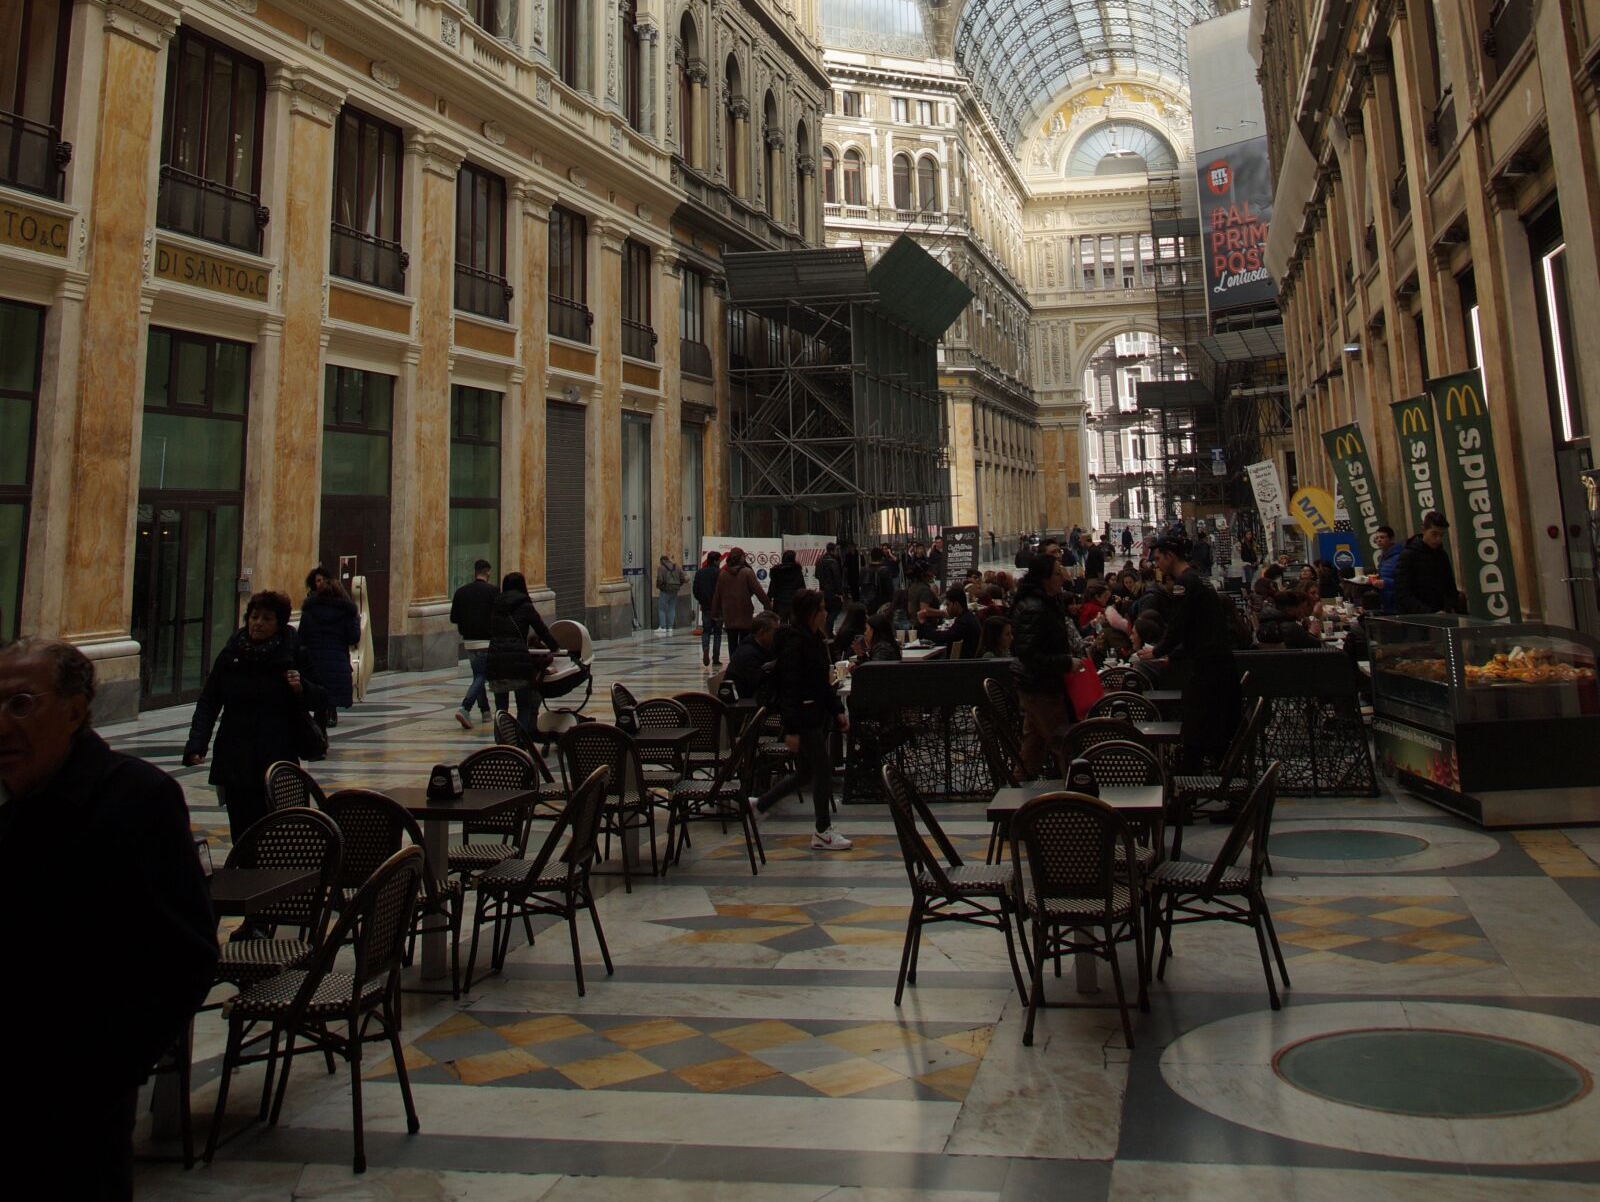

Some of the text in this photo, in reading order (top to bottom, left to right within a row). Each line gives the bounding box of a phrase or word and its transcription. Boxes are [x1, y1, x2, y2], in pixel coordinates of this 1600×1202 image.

[1211, 167, 1228, 179] RTL
[1210, 200, 1257, 229] #AL
[1211, 221, 1269, 254] PRIM
[157, 250, 177, 276] DI
[1213, 245, 1265, 278] POS
[1213, 267, 1268, 293] L'entusia
[1457, 426, 1512, 624] cDonald's
